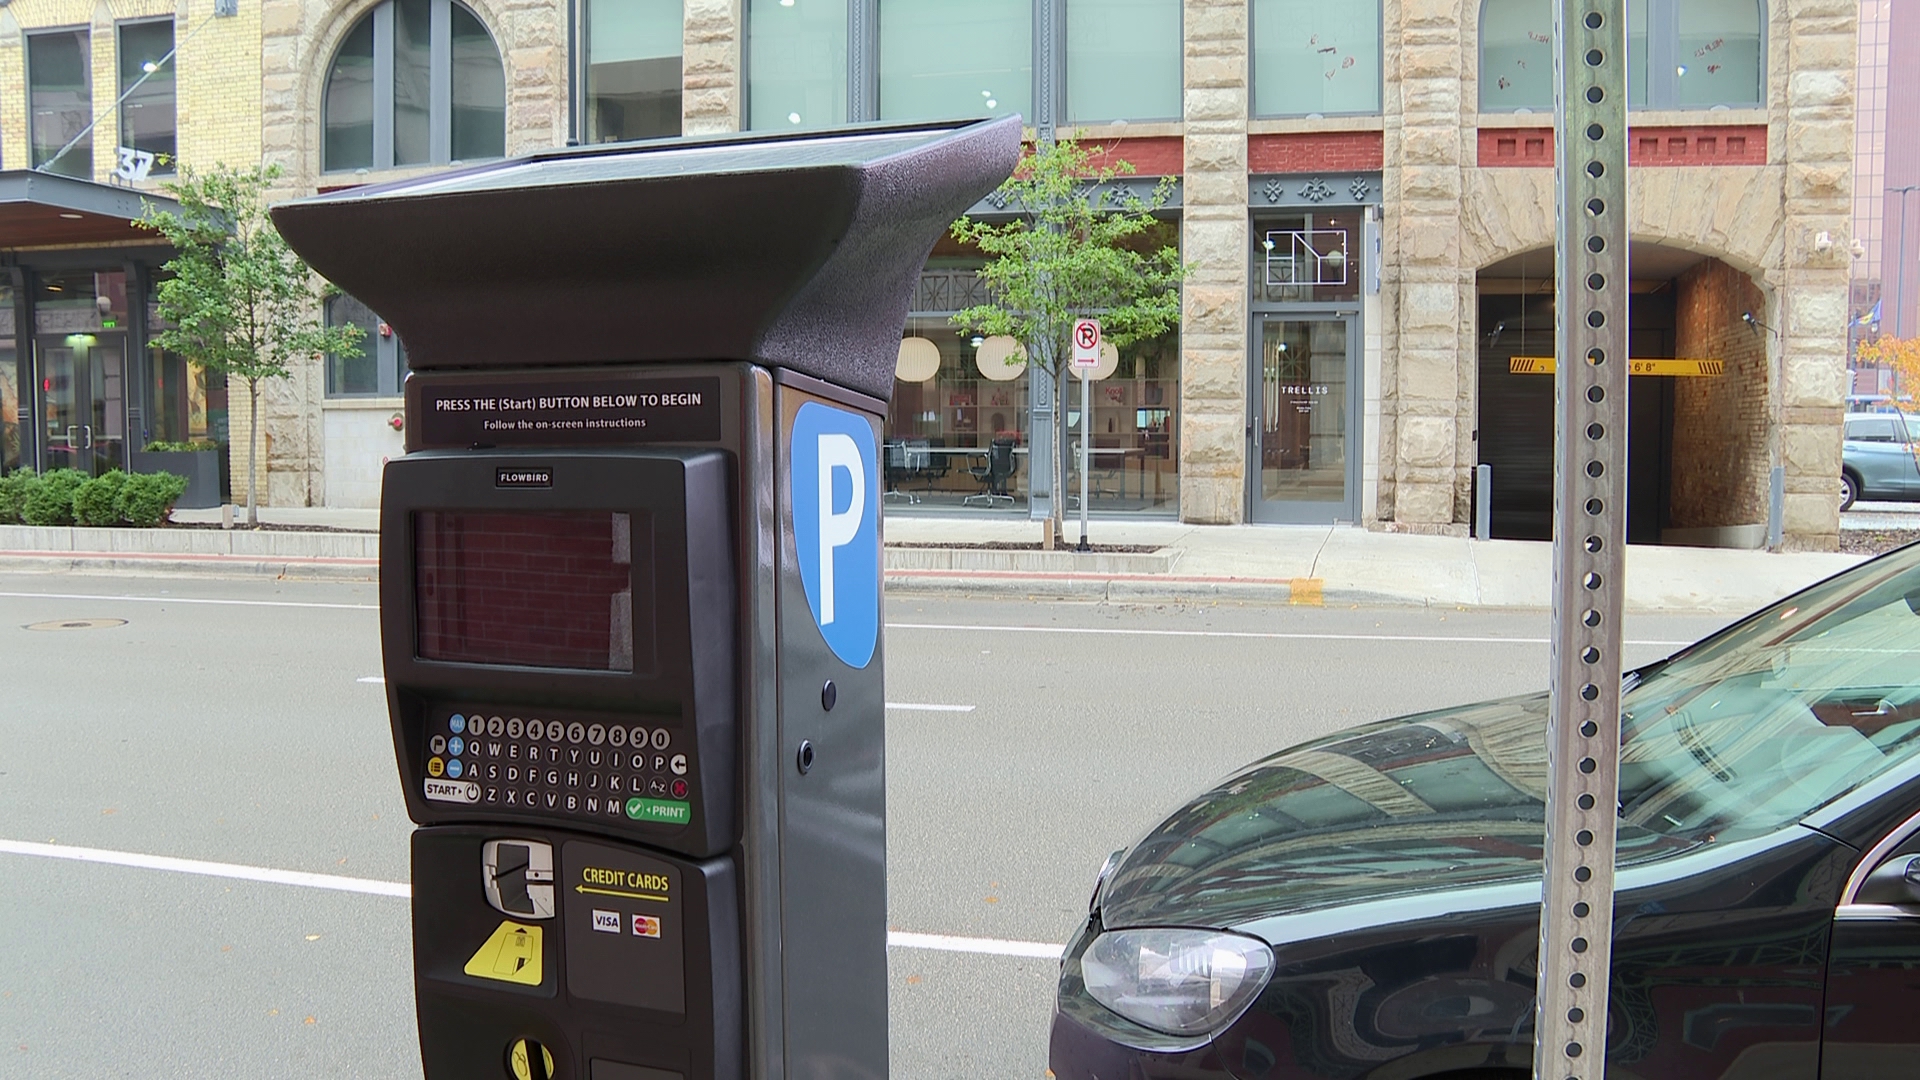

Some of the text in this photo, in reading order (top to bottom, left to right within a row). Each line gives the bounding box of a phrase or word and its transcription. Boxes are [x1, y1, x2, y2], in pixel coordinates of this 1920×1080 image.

[112, 146, 154, 182] 37
[1105, 386, 1123, 395] Knoll
[1281, 386, 1328, 395] TRELLIS
[436, 393, 701, 411] PRESS THE (Start) BUTTON BELOW TO BEGIN
[484, 417, 647, 430] Follow the on-screen instructions
[500, 473, 549, 482] FLOWBIRD
[818, 433, 866, 626] P
[473, 719, 665, 747] 1 2 3 4 5 6 7 8 9 0
[469, 741, 664, 770] Q W E R T Y U I O P
[468, 763, 665, 793] A S D F G H J K L A-Z
[427, 783, 457, 796] START
[487, 788, 620, 814] Z X C V B N M
[652, 805, 685, 818] PRINT
[583, 867, 669, 892] CREDIT CARDS
[595, 915, 618, 928] VISA
